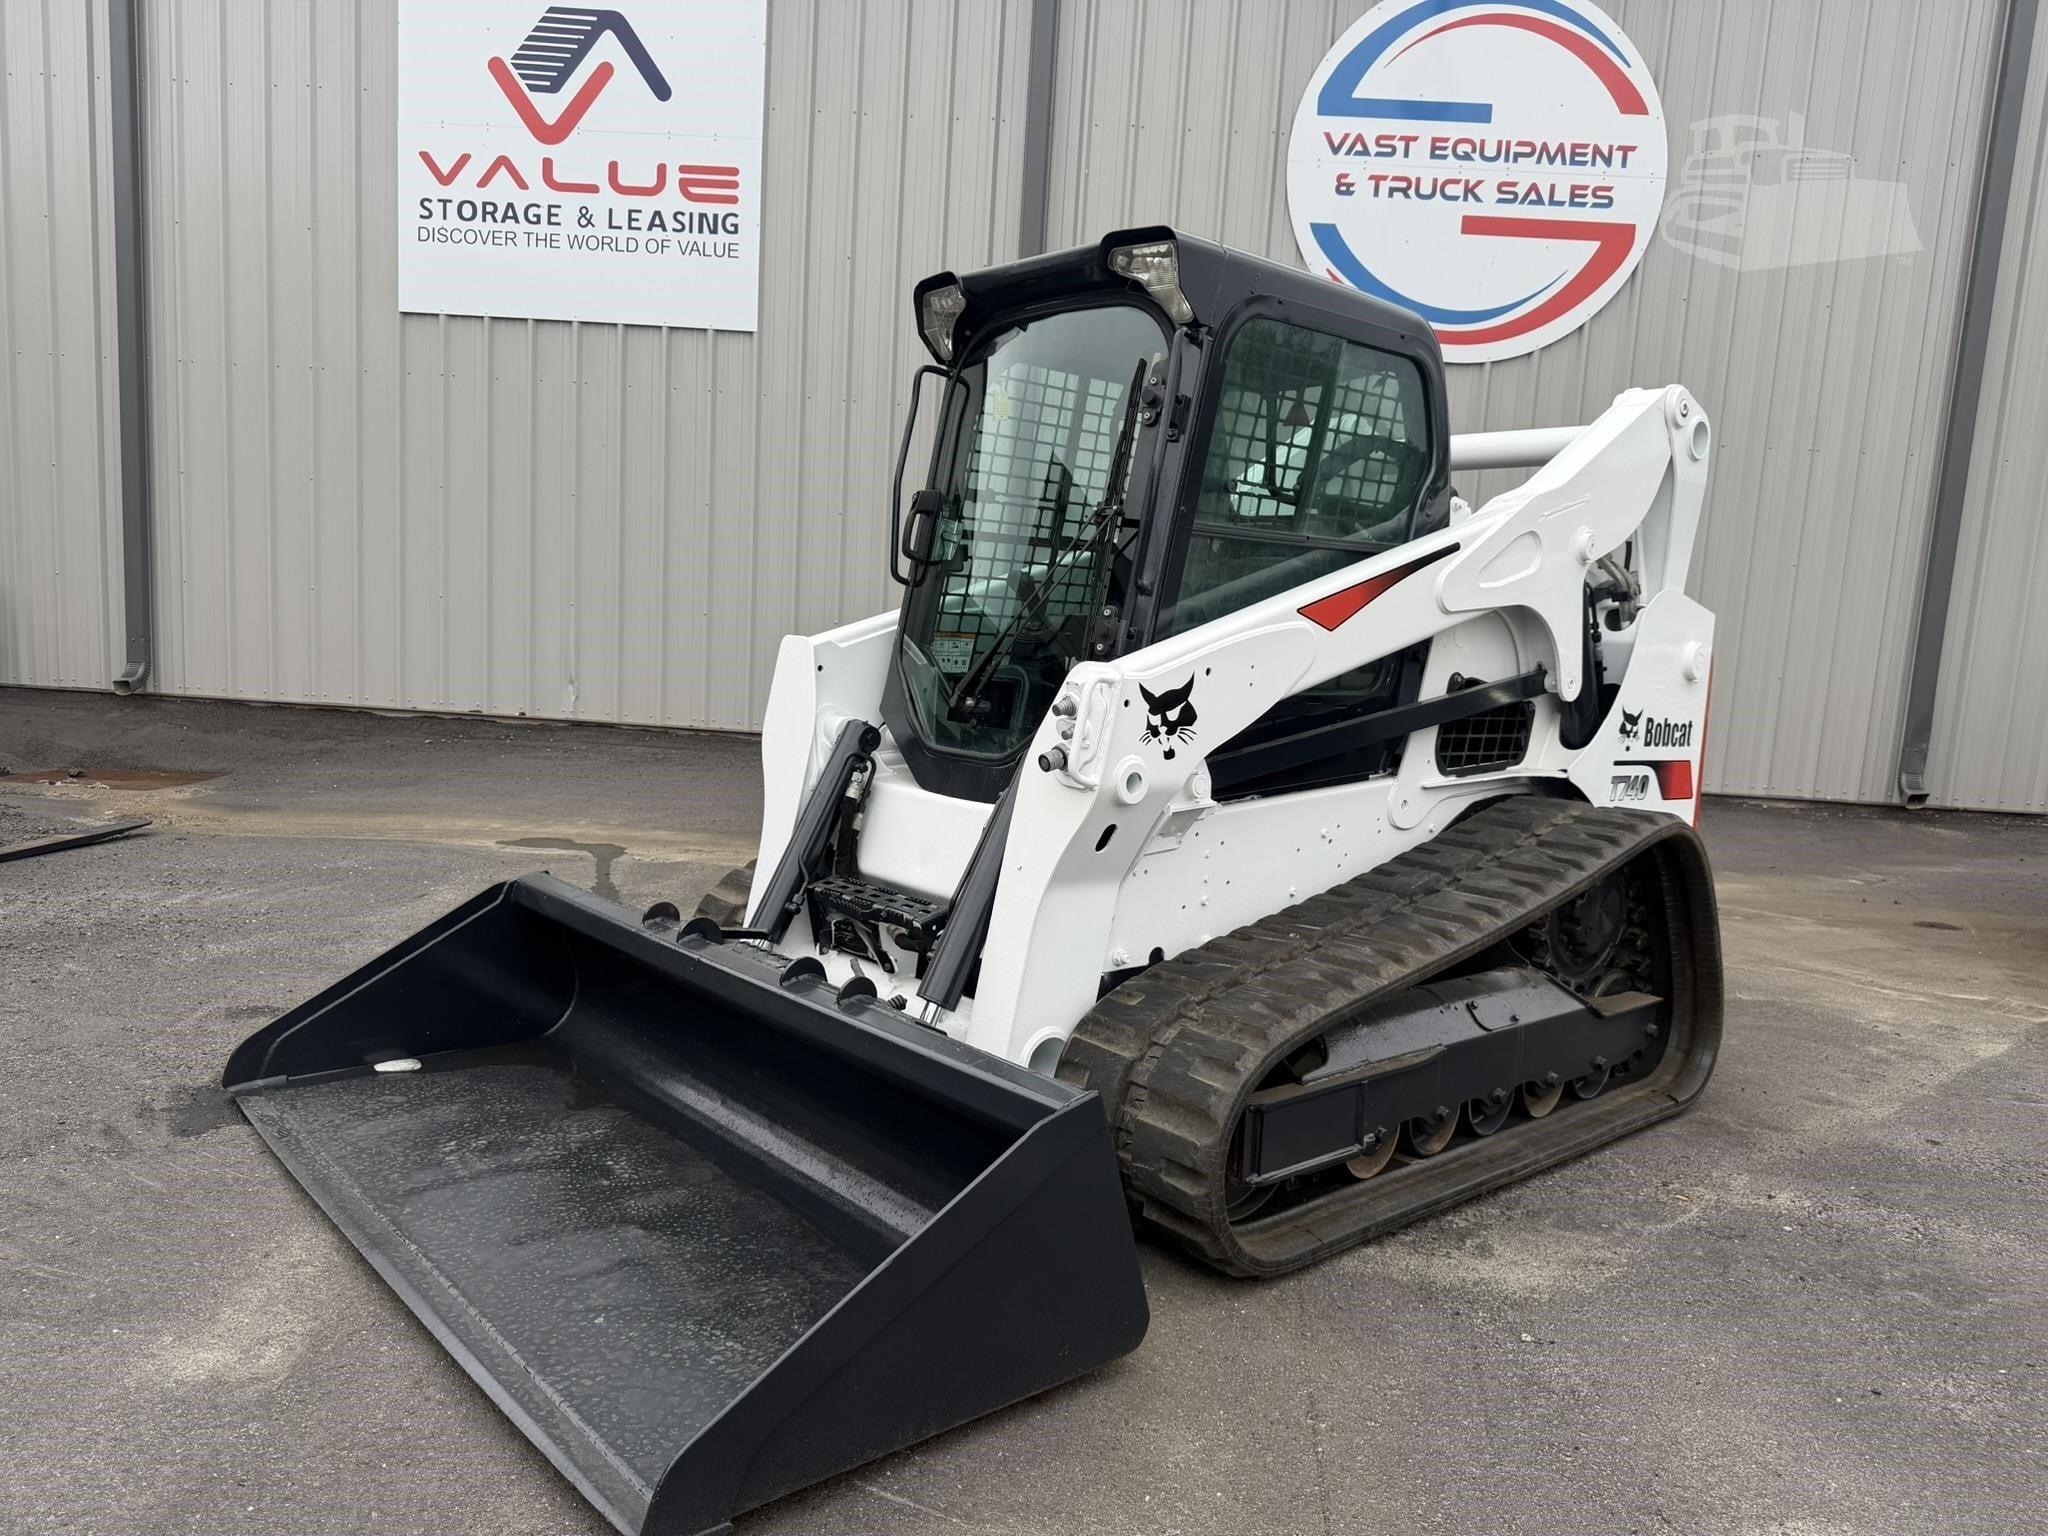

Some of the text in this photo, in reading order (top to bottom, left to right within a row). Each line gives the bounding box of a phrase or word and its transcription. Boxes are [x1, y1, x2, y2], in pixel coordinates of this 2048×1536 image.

[1323, 131, 1638, 169] VAST EQUIPMENT
[418, 150, 740, 205] VALUE
[1334, 172, 1615, 209] & TRUCK SALES
[418, 197, 740, 235] STORAGE & LEASING
[417, 226, 740, 259] DISCOVER THE WORLD OF VALUE
[1643, 717, 1693, 747] Bobcat
[1609, 774, 1650, 802] T740
